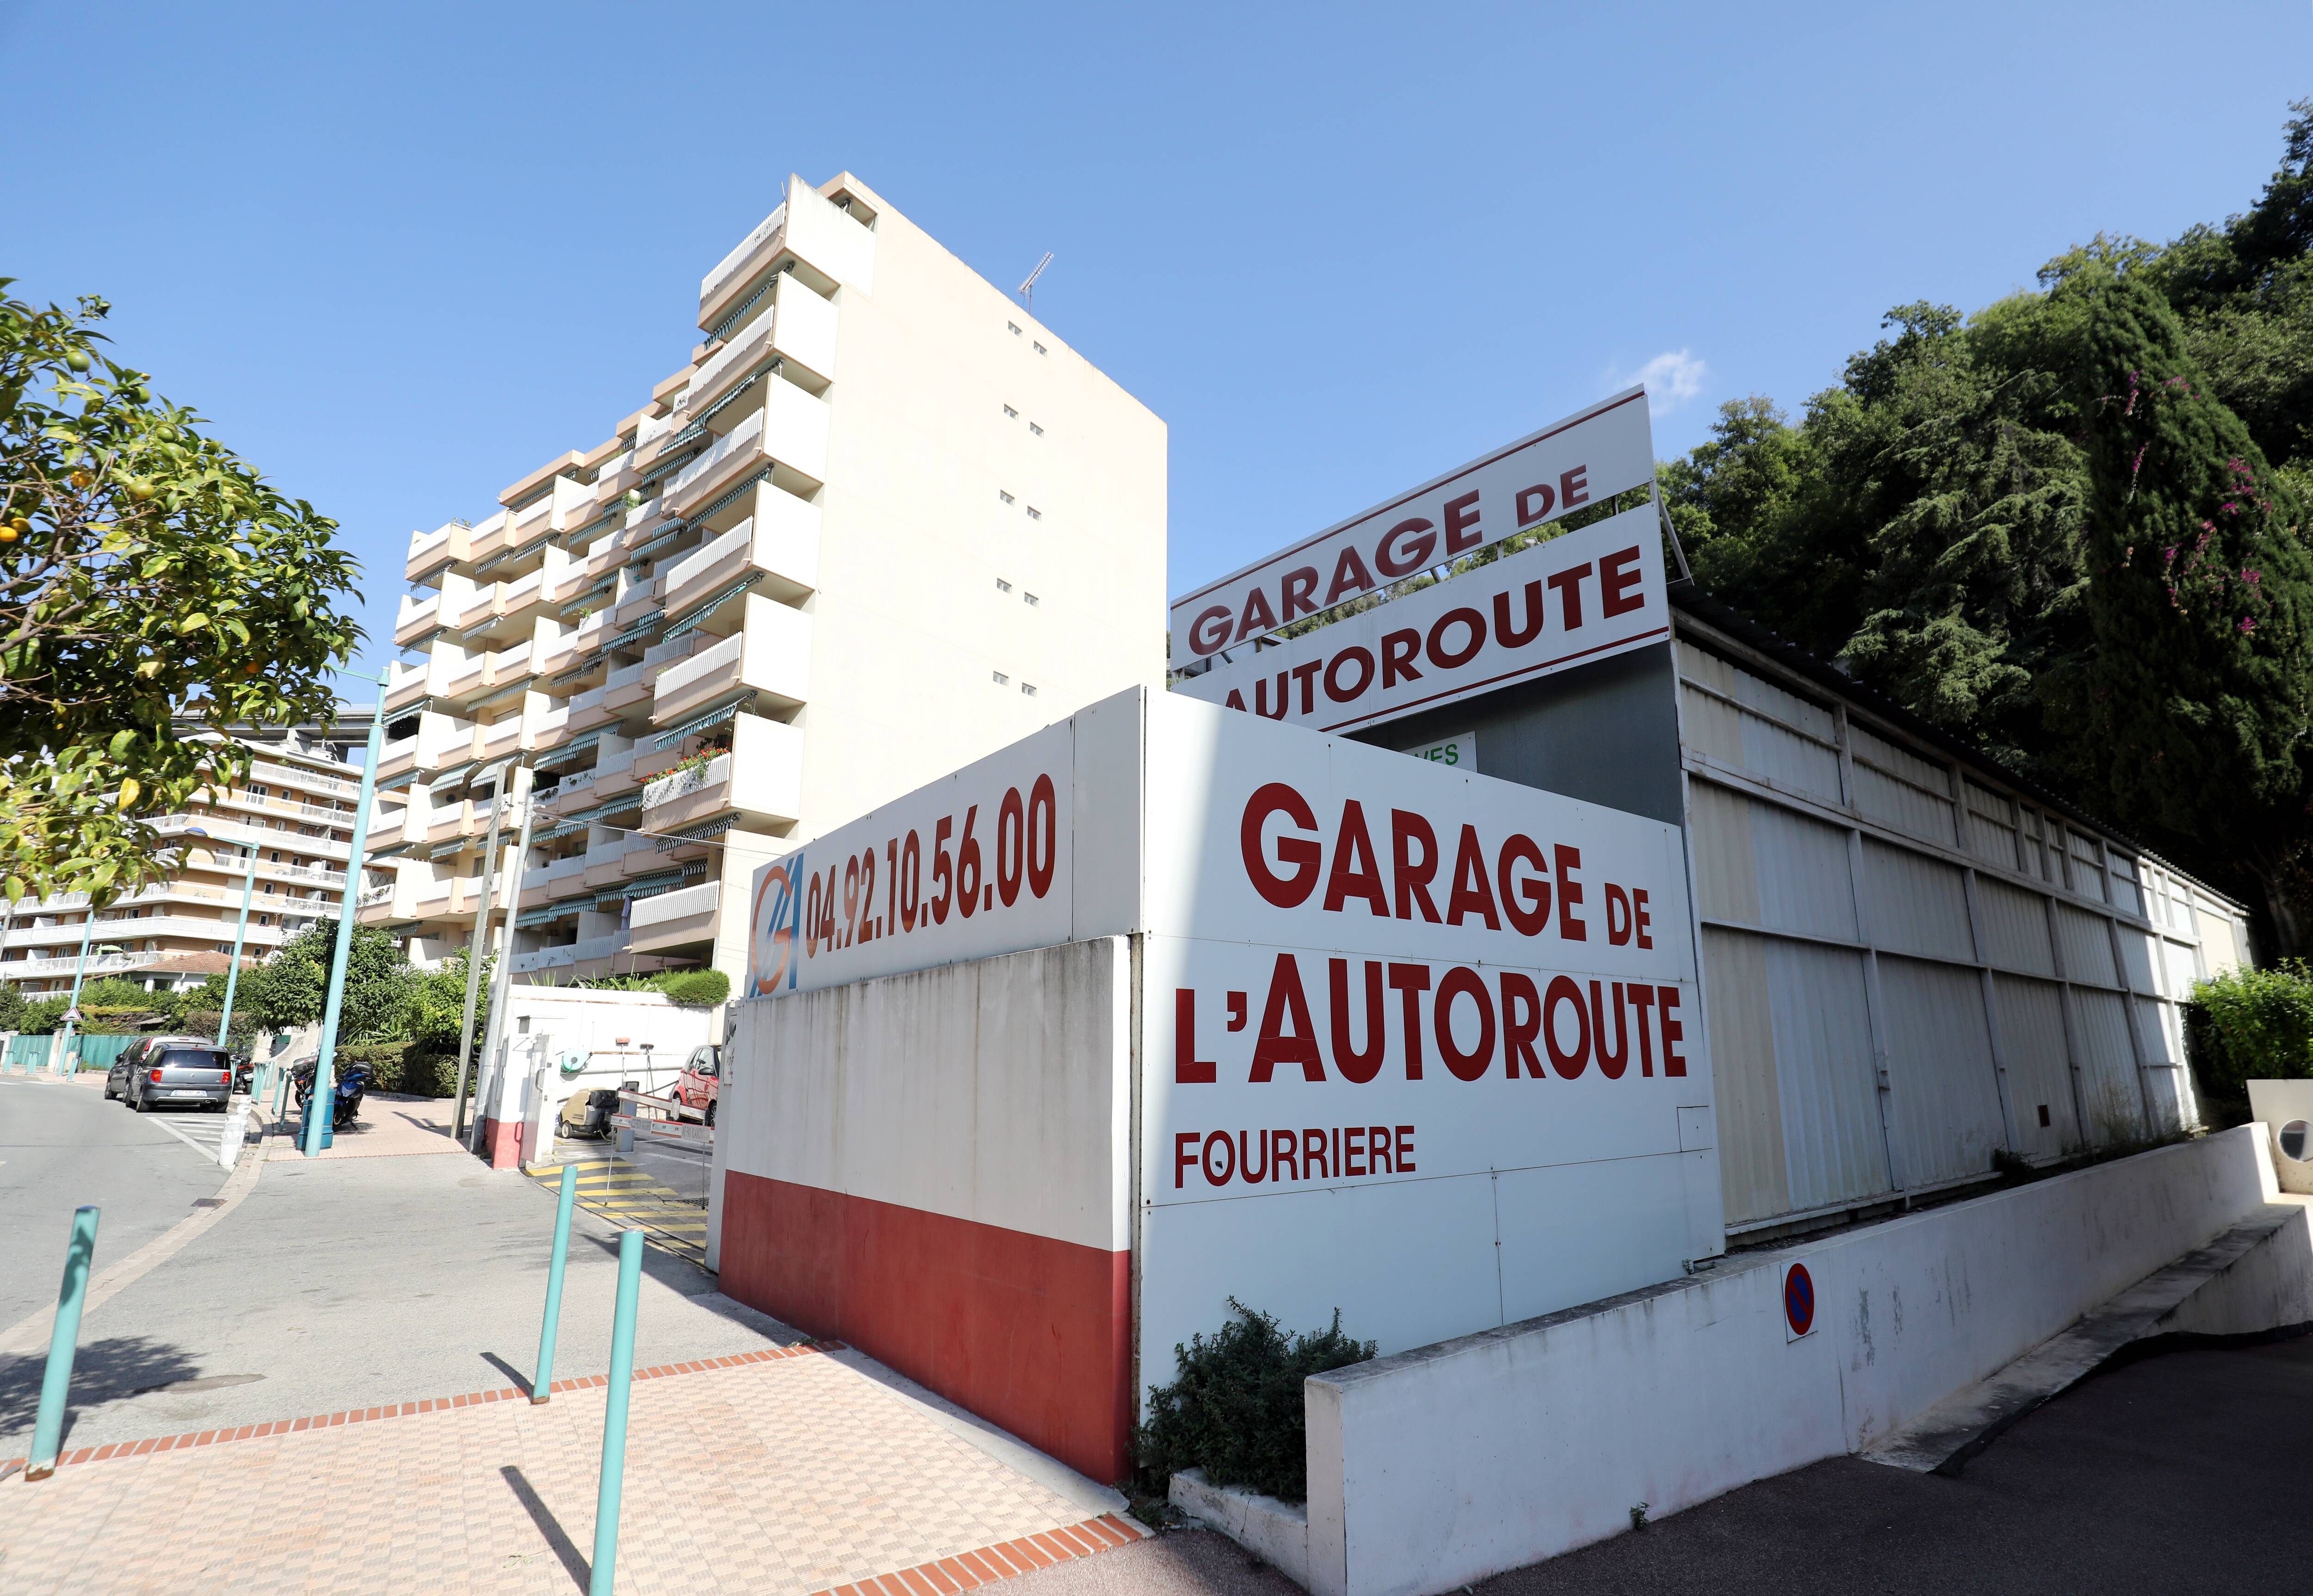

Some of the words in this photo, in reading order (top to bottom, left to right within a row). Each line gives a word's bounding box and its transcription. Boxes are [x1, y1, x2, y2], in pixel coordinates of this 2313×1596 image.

[1188, 489, 1483, 656] GARAGE
[1515, 464, 1589, 528] DE
[806, 773, 1056, 959] 04.92.10.56.00
[1241, 783, 1587, 942] GARAGE
[1604, 883, 1653, 949] DE
[1175, 953, 1687, 1084] L'AUTOROUTE
[1175, 1125, 1416, 1189] FOURRIERE
